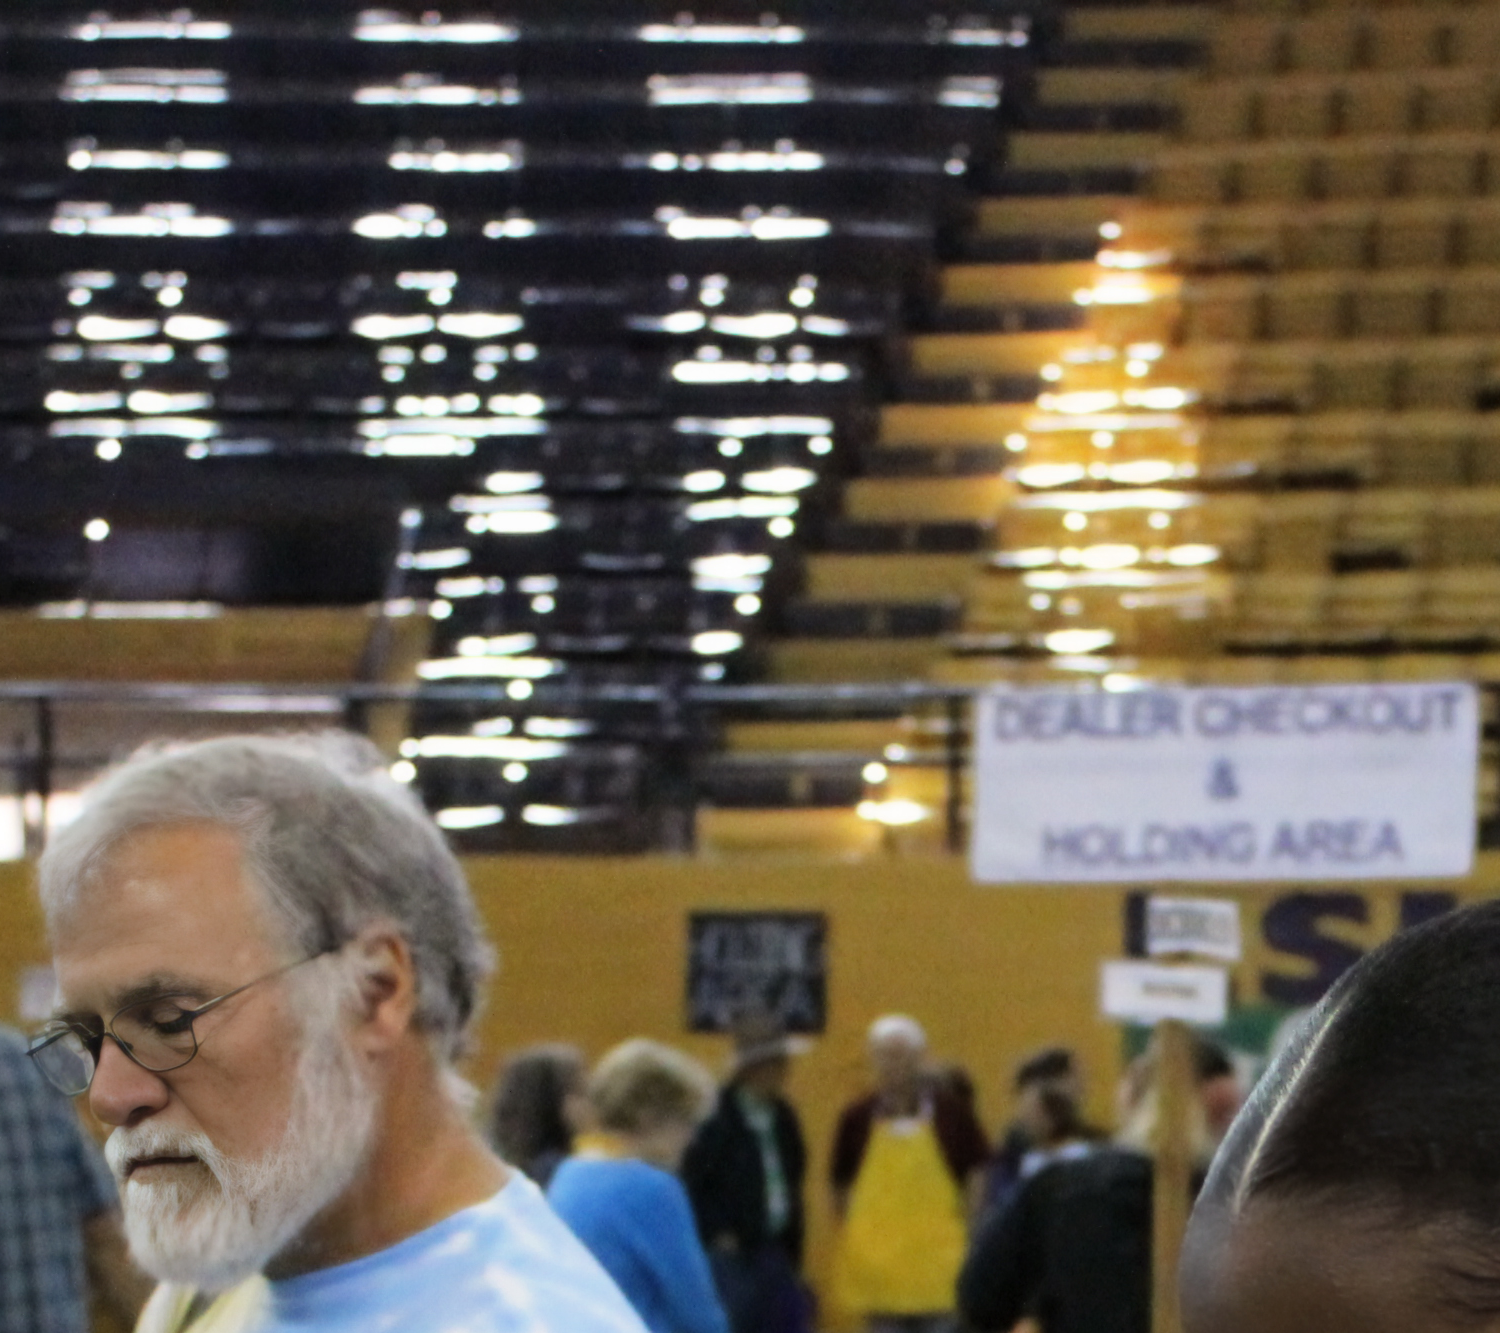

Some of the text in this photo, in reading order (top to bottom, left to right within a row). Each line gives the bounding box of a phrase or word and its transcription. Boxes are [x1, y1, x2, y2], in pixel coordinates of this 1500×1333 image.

[993, 690, 1461, 740] DEALER CHECKOUT
[1040, 819, 1402, 865] HOLDING AREA
